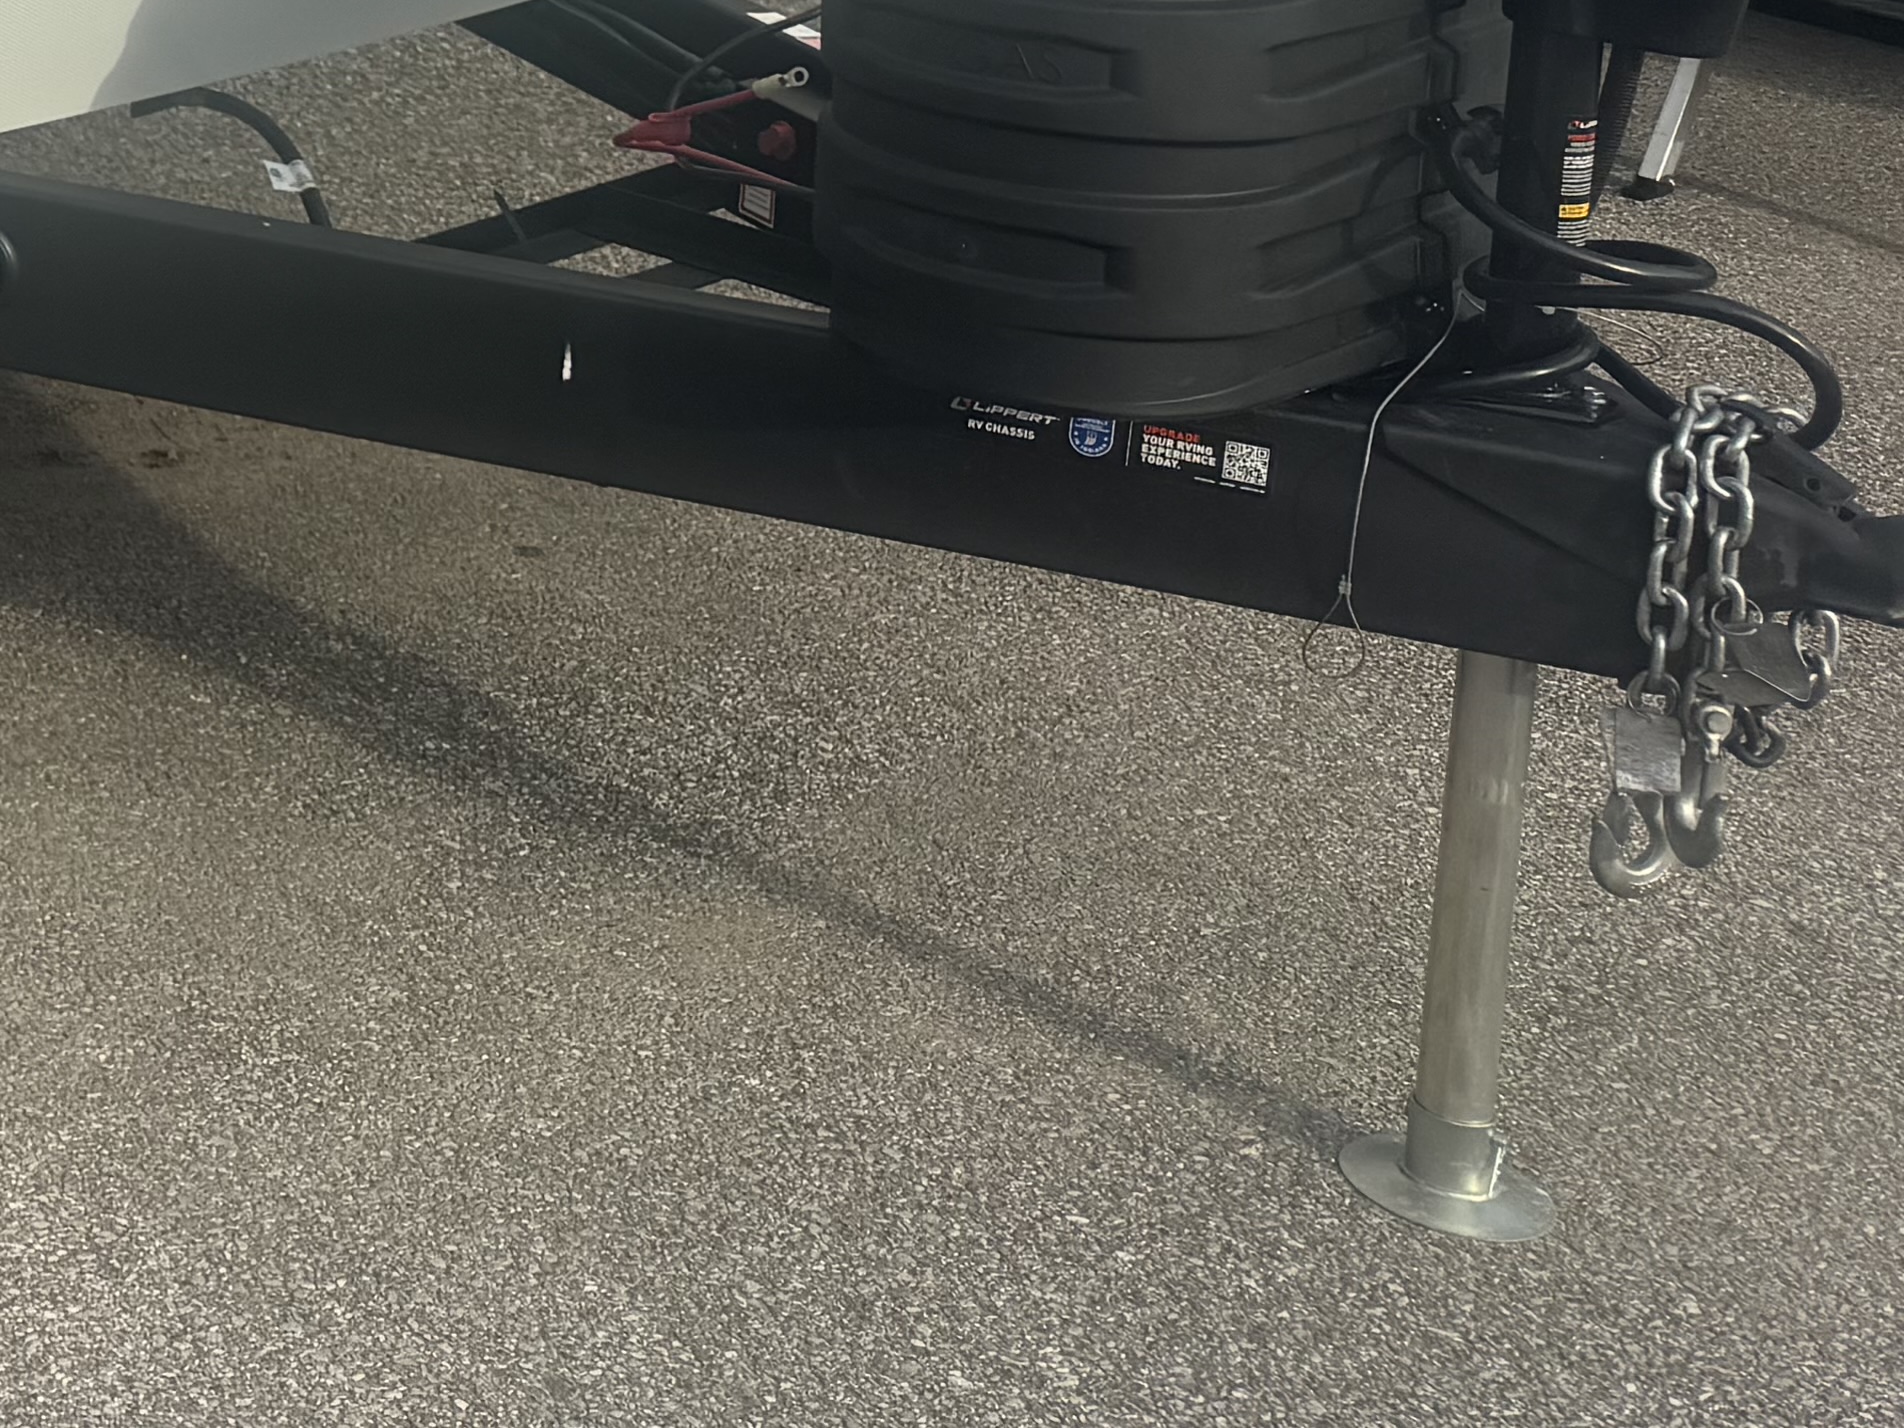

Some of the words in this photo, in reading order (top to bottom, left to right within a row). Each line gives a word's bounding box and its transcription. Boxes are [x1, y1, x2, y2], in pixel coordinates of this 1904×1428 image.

[968, 418, 984, 430] RV
[985, 422, 1036, 441] CHASSIS
[1143, 423, 1201, 443] UPGRADE
[1141, 443, 1217, 467] EXPERIENCE
[1142, 433, 1175, 449] YOUR
[1176, 440, 1214, 456] RVING
[1140, 452, 1181, 470] TODAY.
